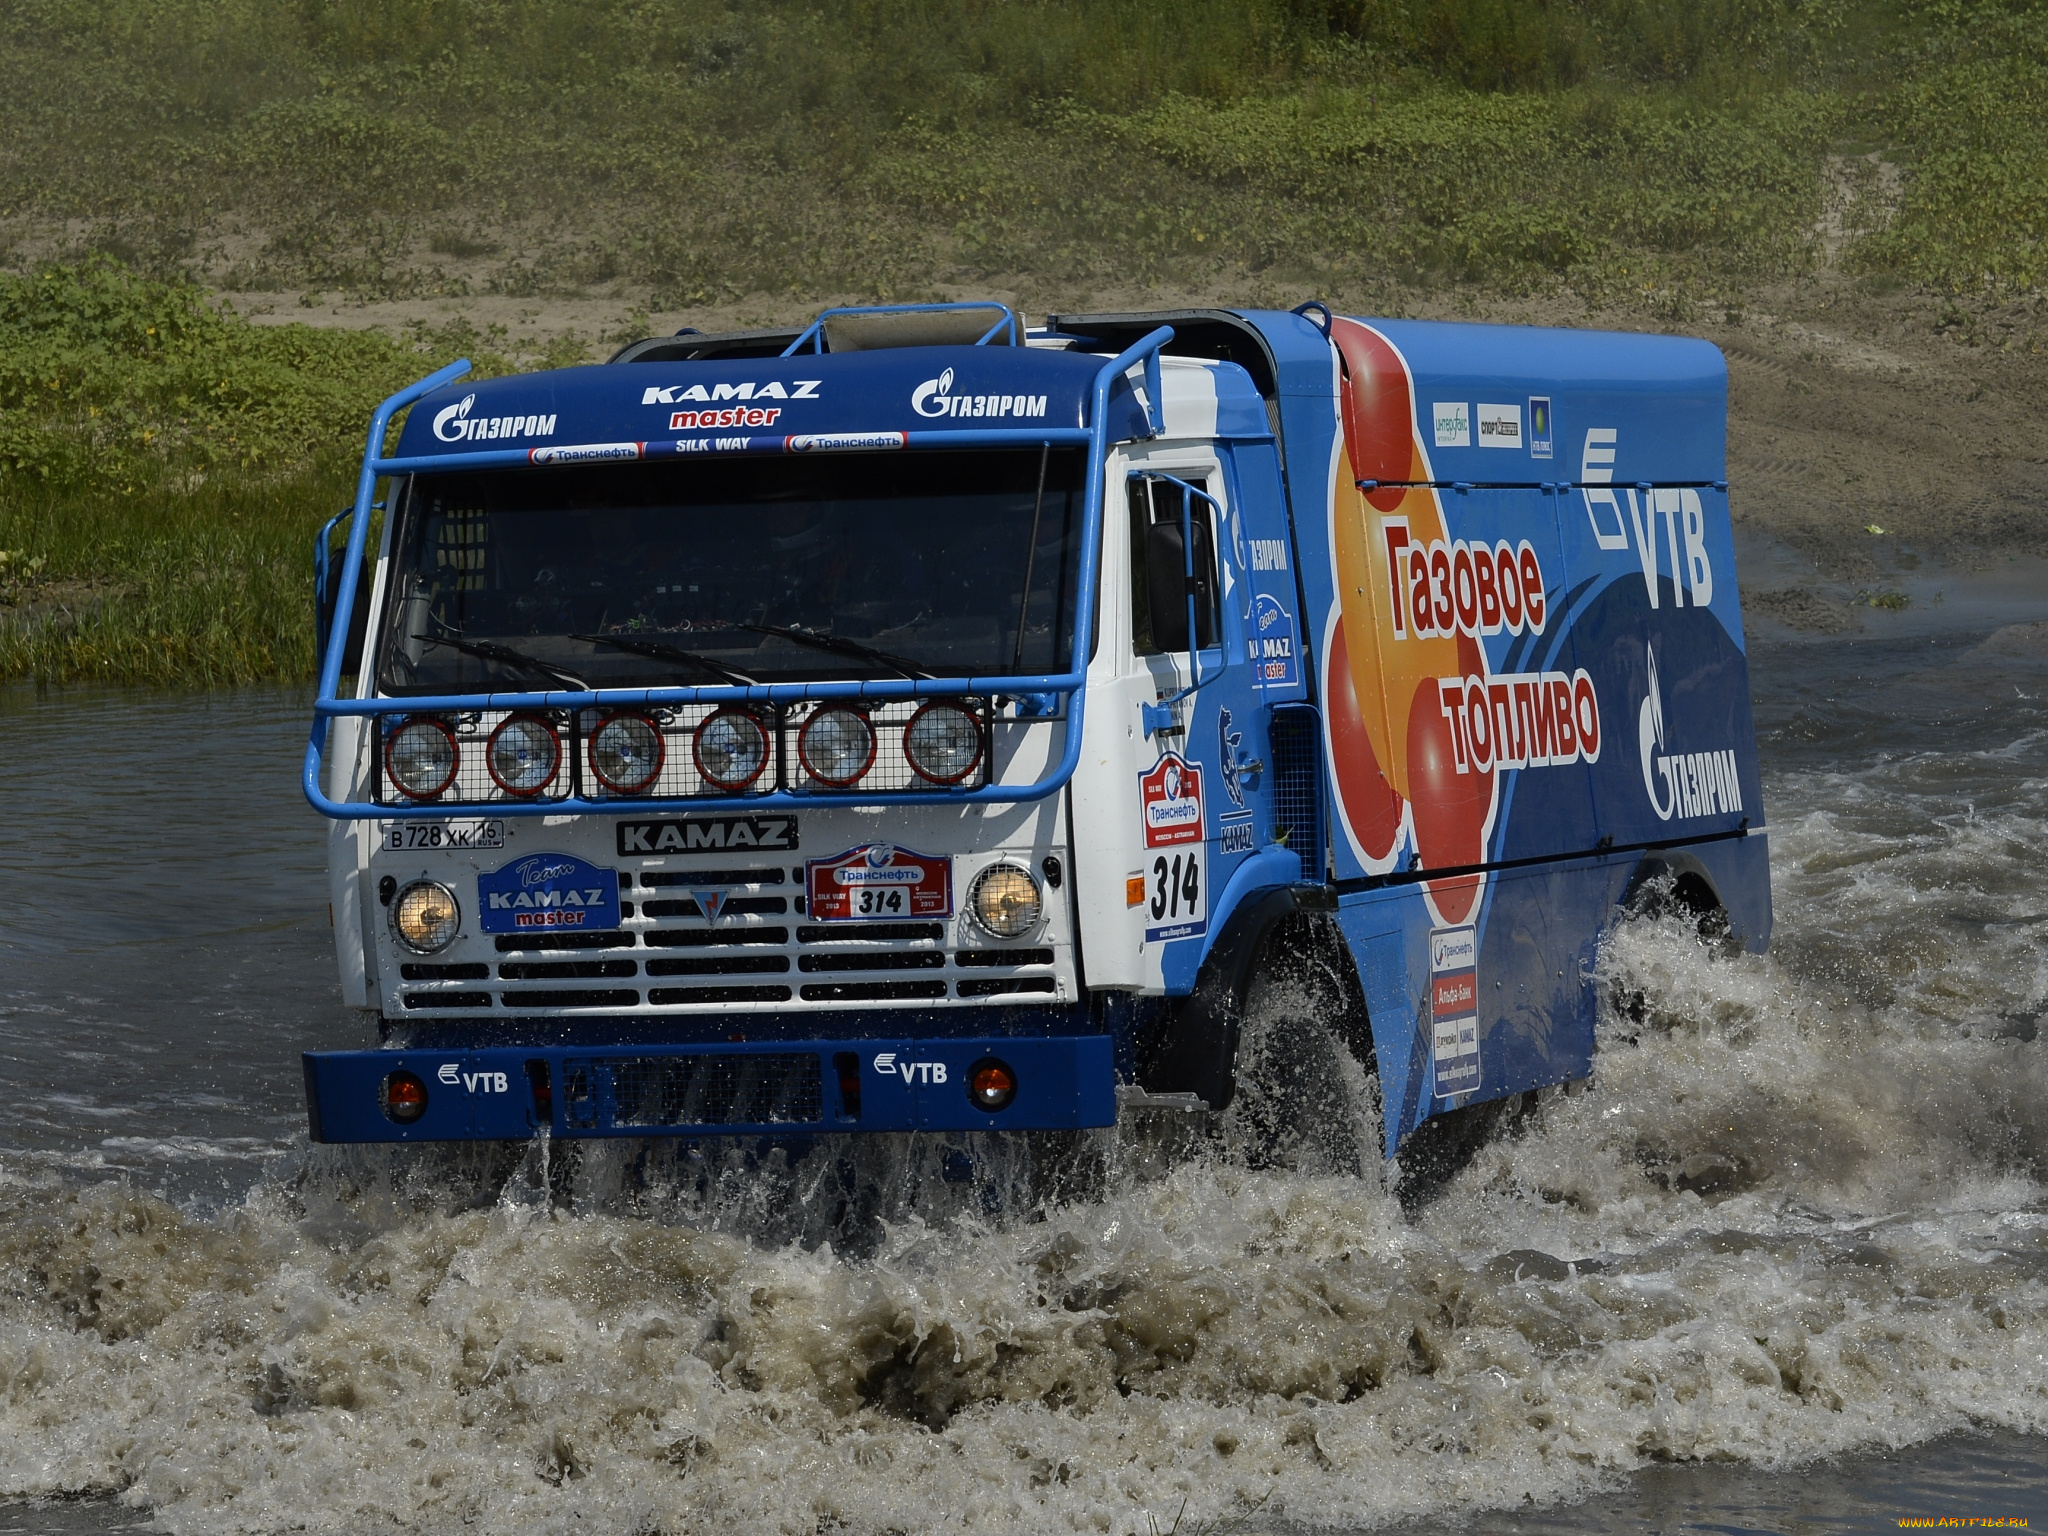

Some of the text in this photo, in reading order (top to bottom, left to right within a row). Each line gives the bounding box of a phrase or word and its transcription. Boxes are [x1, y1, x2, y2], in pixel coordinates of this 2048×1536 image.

[642, 380, 822, 405] KAMAZ
[669, 406, 781, 430] master
[949, 395, 1048, 418] ГАЗПРОМ
[466, 414, 558, 441] ГАЗПРОМ
[675, 437, 752, 453] SILK WAY
[816, 434, 901, 451] Транснефть
[556, 447, 636, 462] Транснефть
[1627, 488, 1713, 610] VTB
[1383, 520, 1545, 637] Газовое
[1248, 637, 1292, 659] KMAZ
[1440, 671, 1600, 771] топливо
[1670, 749, 1743, 819] ГАЗПРОМ
[1150, 802, 1196, 824] Транснефть
[406, 826, 442, 848] 728
[477, 823, 496, 839] 16
[624, 820, 790, 851] KAMAZ
[1220, 822, 1254, 855] KAMAZ
[516, 858, 575, 887] Team
[840, 869, 919, 882] Транснефть
[1151, 851, 1199, 921] 314
[489, 889, 605, 909] KAMAZ
[858, 890, 902, 914] 314
[514, 910, 586, 927] master
[463, 1072, 509, 1093] VTB
[900, 1062, 948, 1084] VTB
